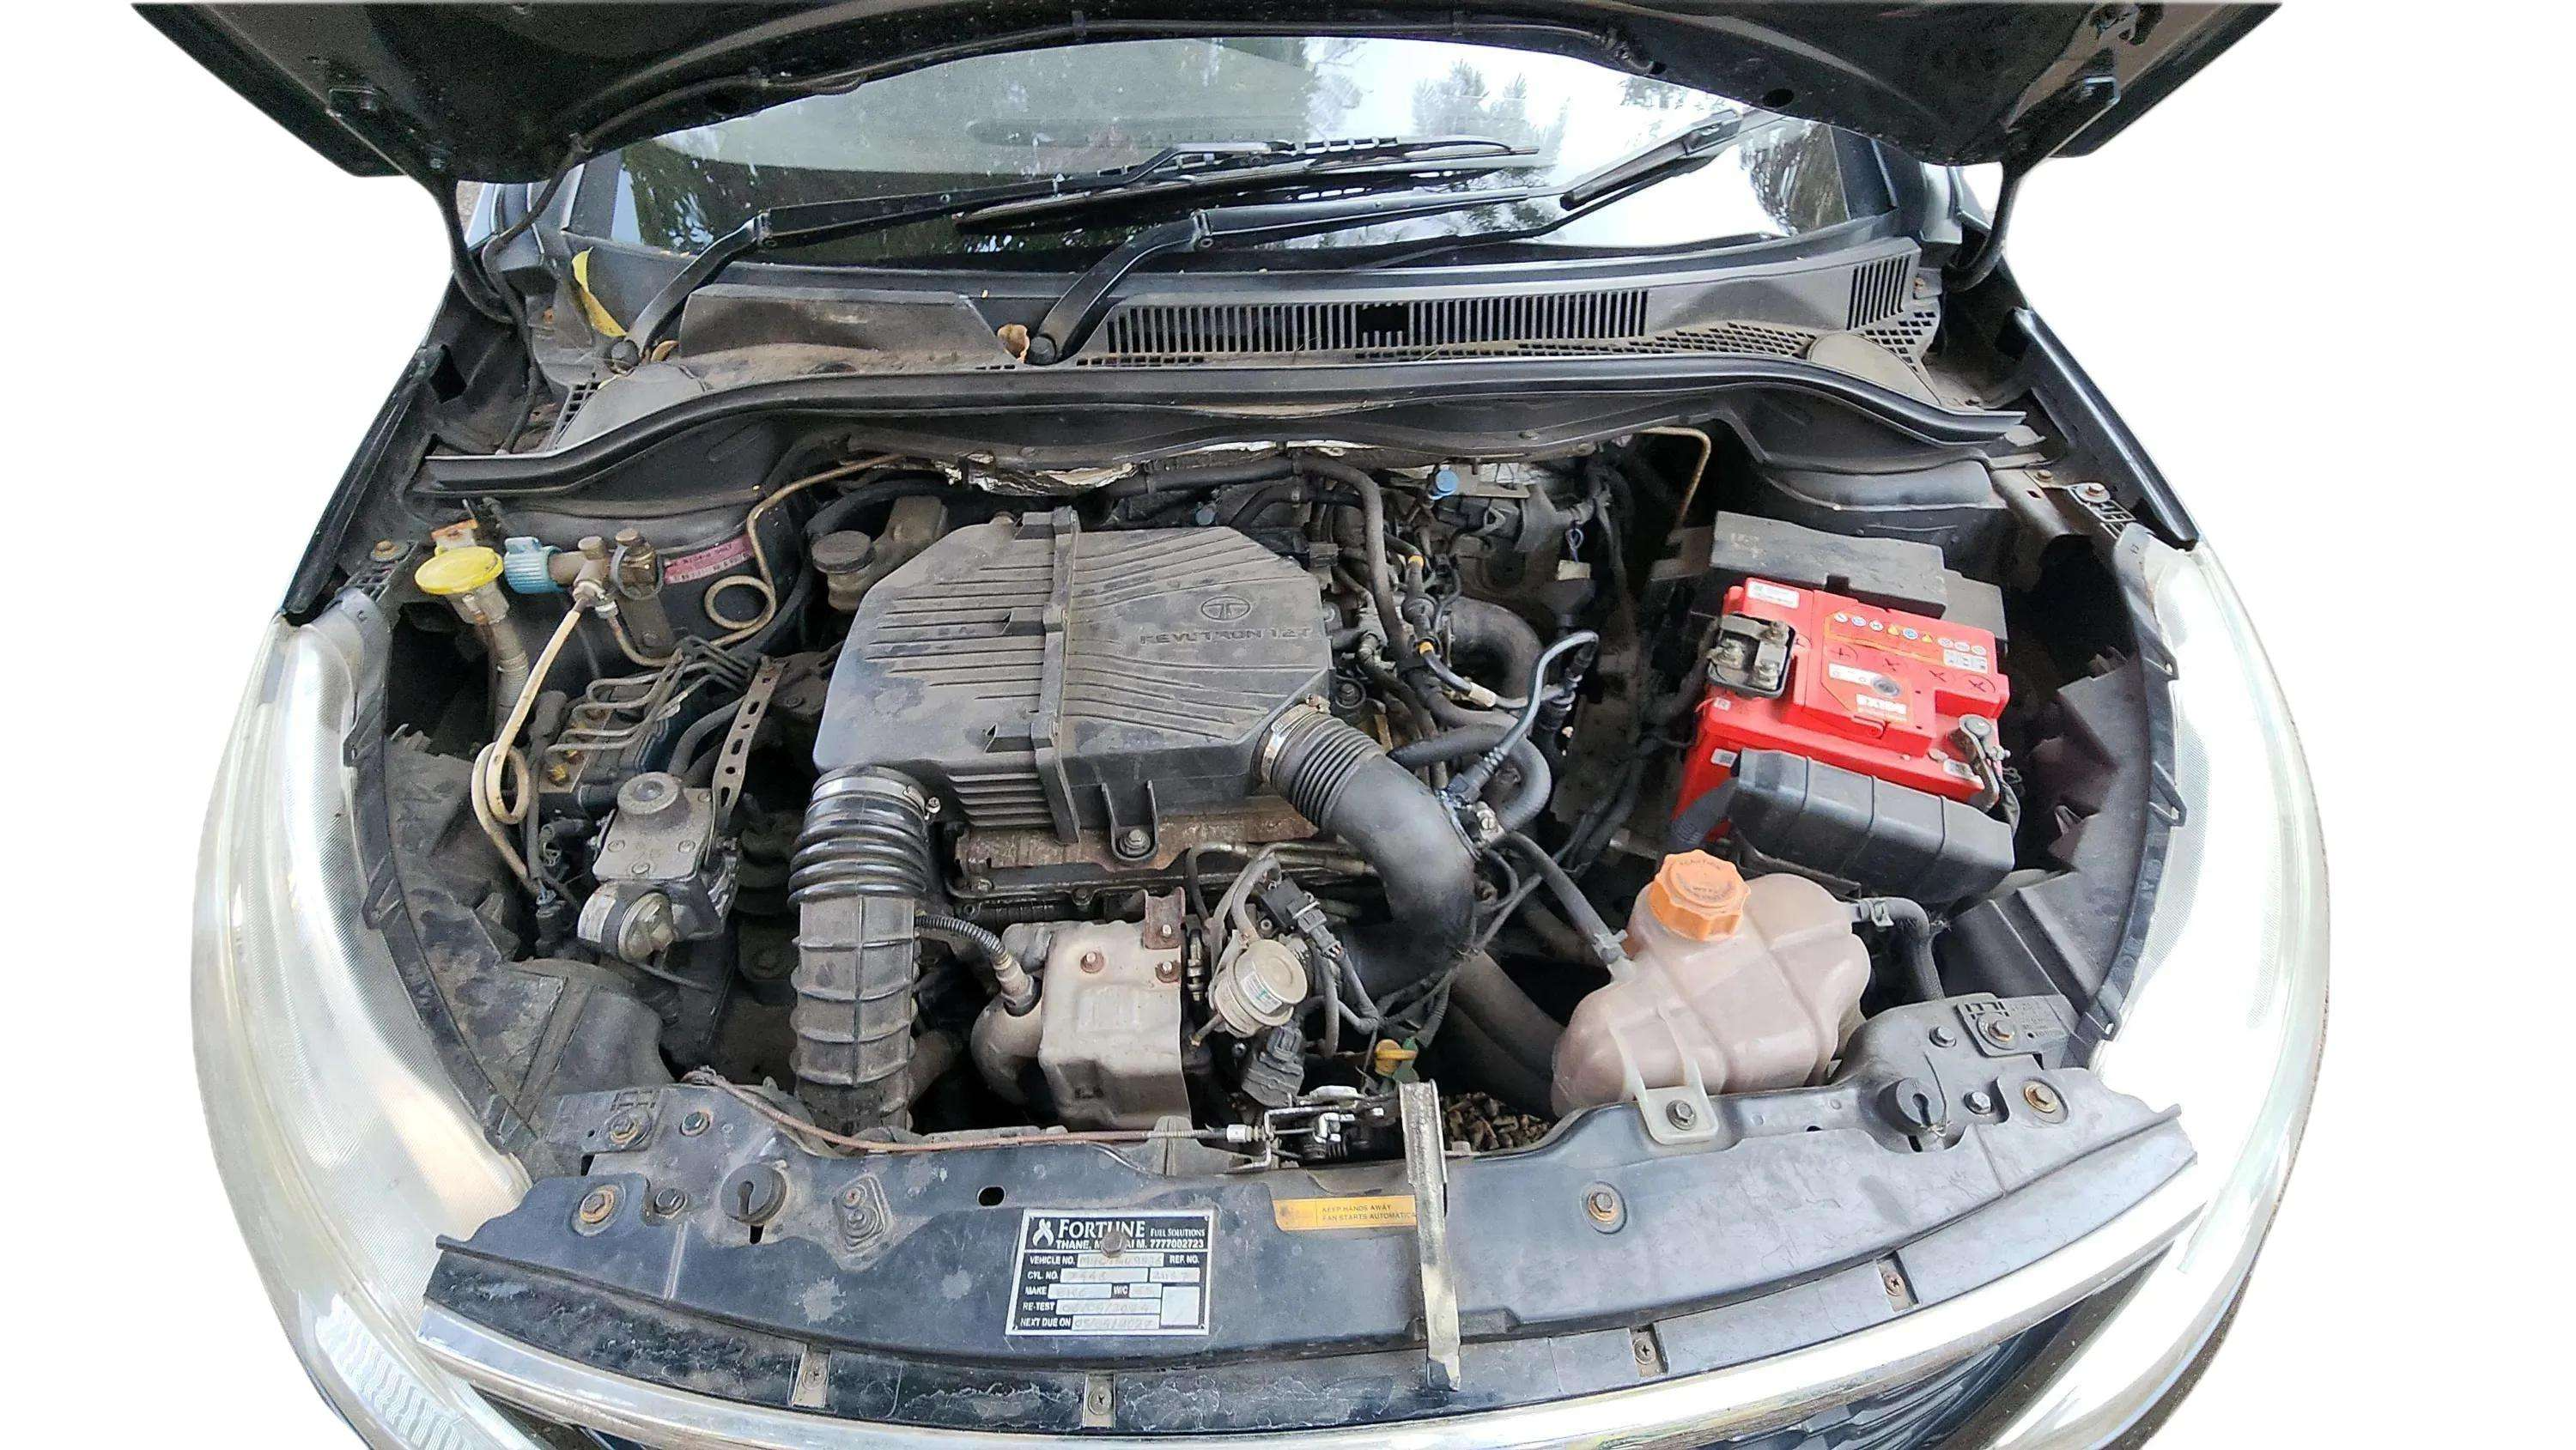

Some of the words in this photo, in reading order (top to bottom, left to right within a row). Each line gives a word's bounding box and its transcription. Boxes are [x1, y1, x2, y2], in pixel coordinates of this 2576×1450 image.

[1058, 1219, 1145, 1239] FORTUNE
[1168, 1229, 1205, 1237] SOLUTIONS
[1055, 1240, 1092, 1250] THANE,
[1151, 1239, 1204, 1248] 7777002723
[1030, 1256, 1060, 1265] VEHICLE
[1062, 1256, 1076, 1265] NO.
[1186, 1255, 1200, 1264] NO.
[1027, 1271, 1043, 1279] CYL.
[1045, 1271, 1059, 1280] NO.
[1024, 1286, 1047, 1295] MAKE
[1023, 1301, 1055, 1311] RE-TEST
[1020, 1318, 1040, 1326] NEXT
[1042, 1318, 1058, 1326] DUE
[1059, 1318, 1071, 1326] ON
